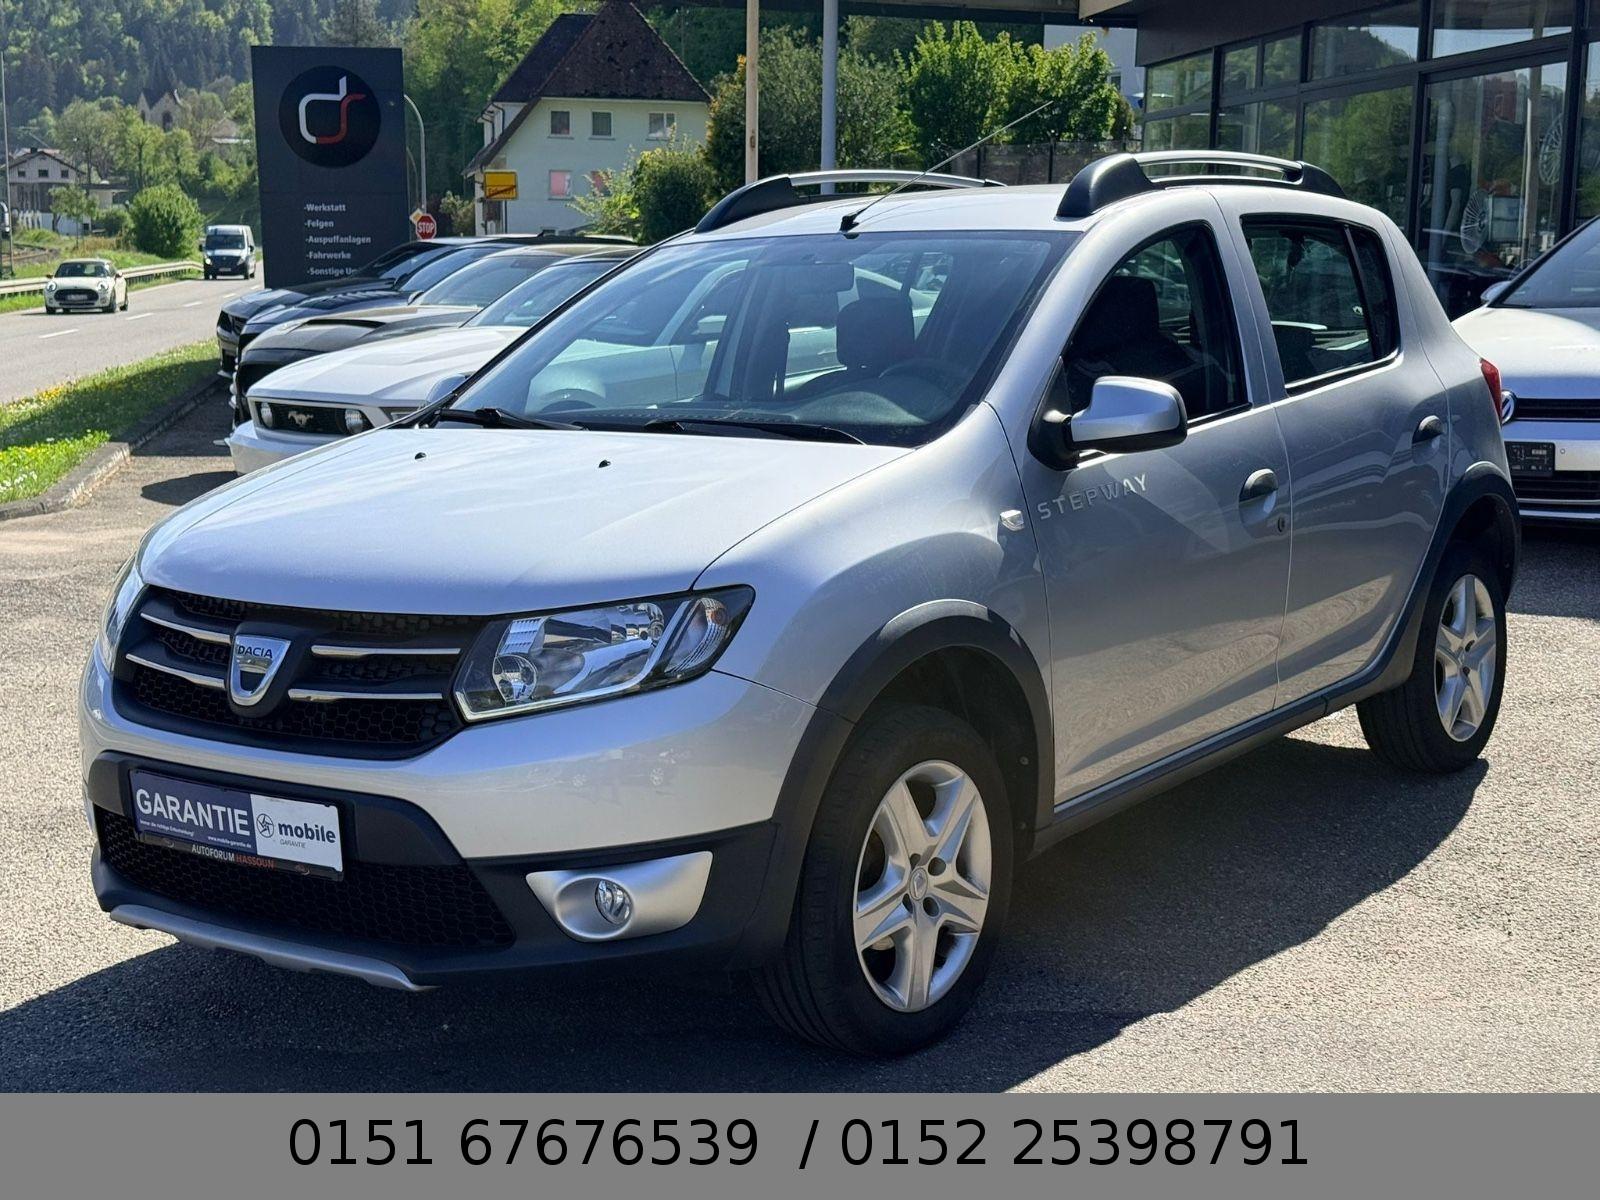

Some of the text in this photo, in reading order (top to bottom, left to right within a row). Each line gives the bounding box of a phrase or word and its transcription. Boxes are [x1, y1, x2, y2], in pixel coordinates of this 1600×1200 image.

[304, 203, 346, 212] -Werkstatt
[304, 219, 334, 229] -Felgen
[418, 222, 435, 233] STOP
[305, 235, 372, 245] -Auspuffanlagen
[306, 251, 352, 259] -Fahrwerke
[307, 267, 344, 276] -Sonstige
[1037, 473, 1147, 520] STEPWAY
[237, 645, 273, 659] DACIA
[136, 788, 250, 836] GARANTIE
[278, 821, 336, 844] mobile
[280, 839, 306, 849] GARANTIE
[191, 843, 275, 869] AUTOFORUM HASSOUN
